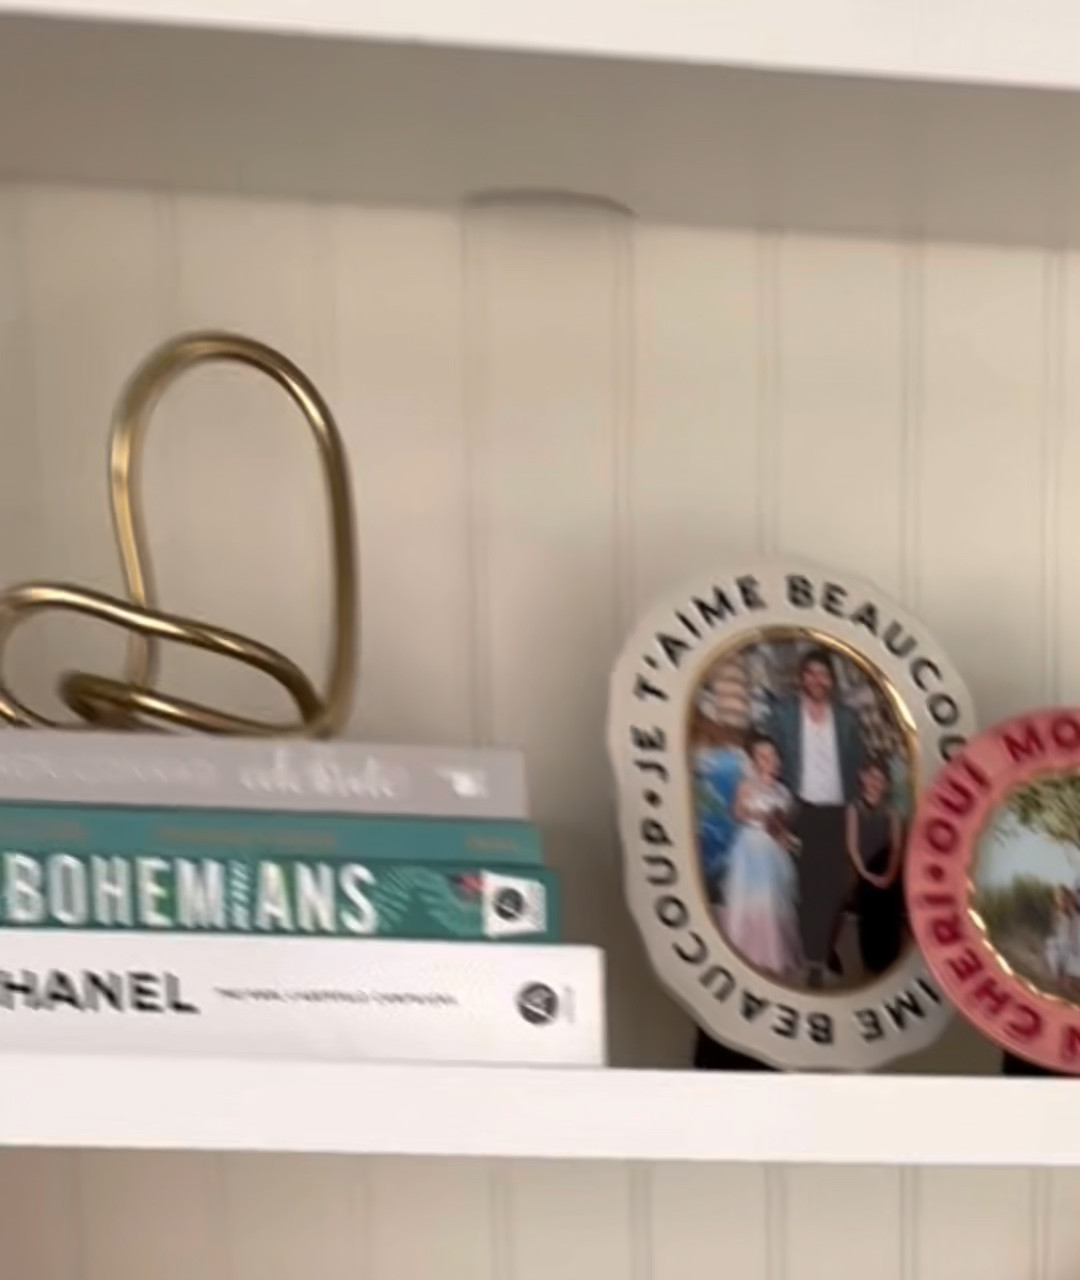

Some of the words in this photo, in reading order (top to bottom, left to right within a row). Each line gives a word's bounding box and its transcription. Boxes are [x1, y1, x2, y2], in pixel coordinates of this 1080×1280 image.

[631, 574, 768, 706] T'AIME
[784, 572, 969, 763] BEAUCOU
[629, 724, 669, 780] JE
[924, 757, 992, 856] OUI
[922, 892, 1043, 1043] CHERI
